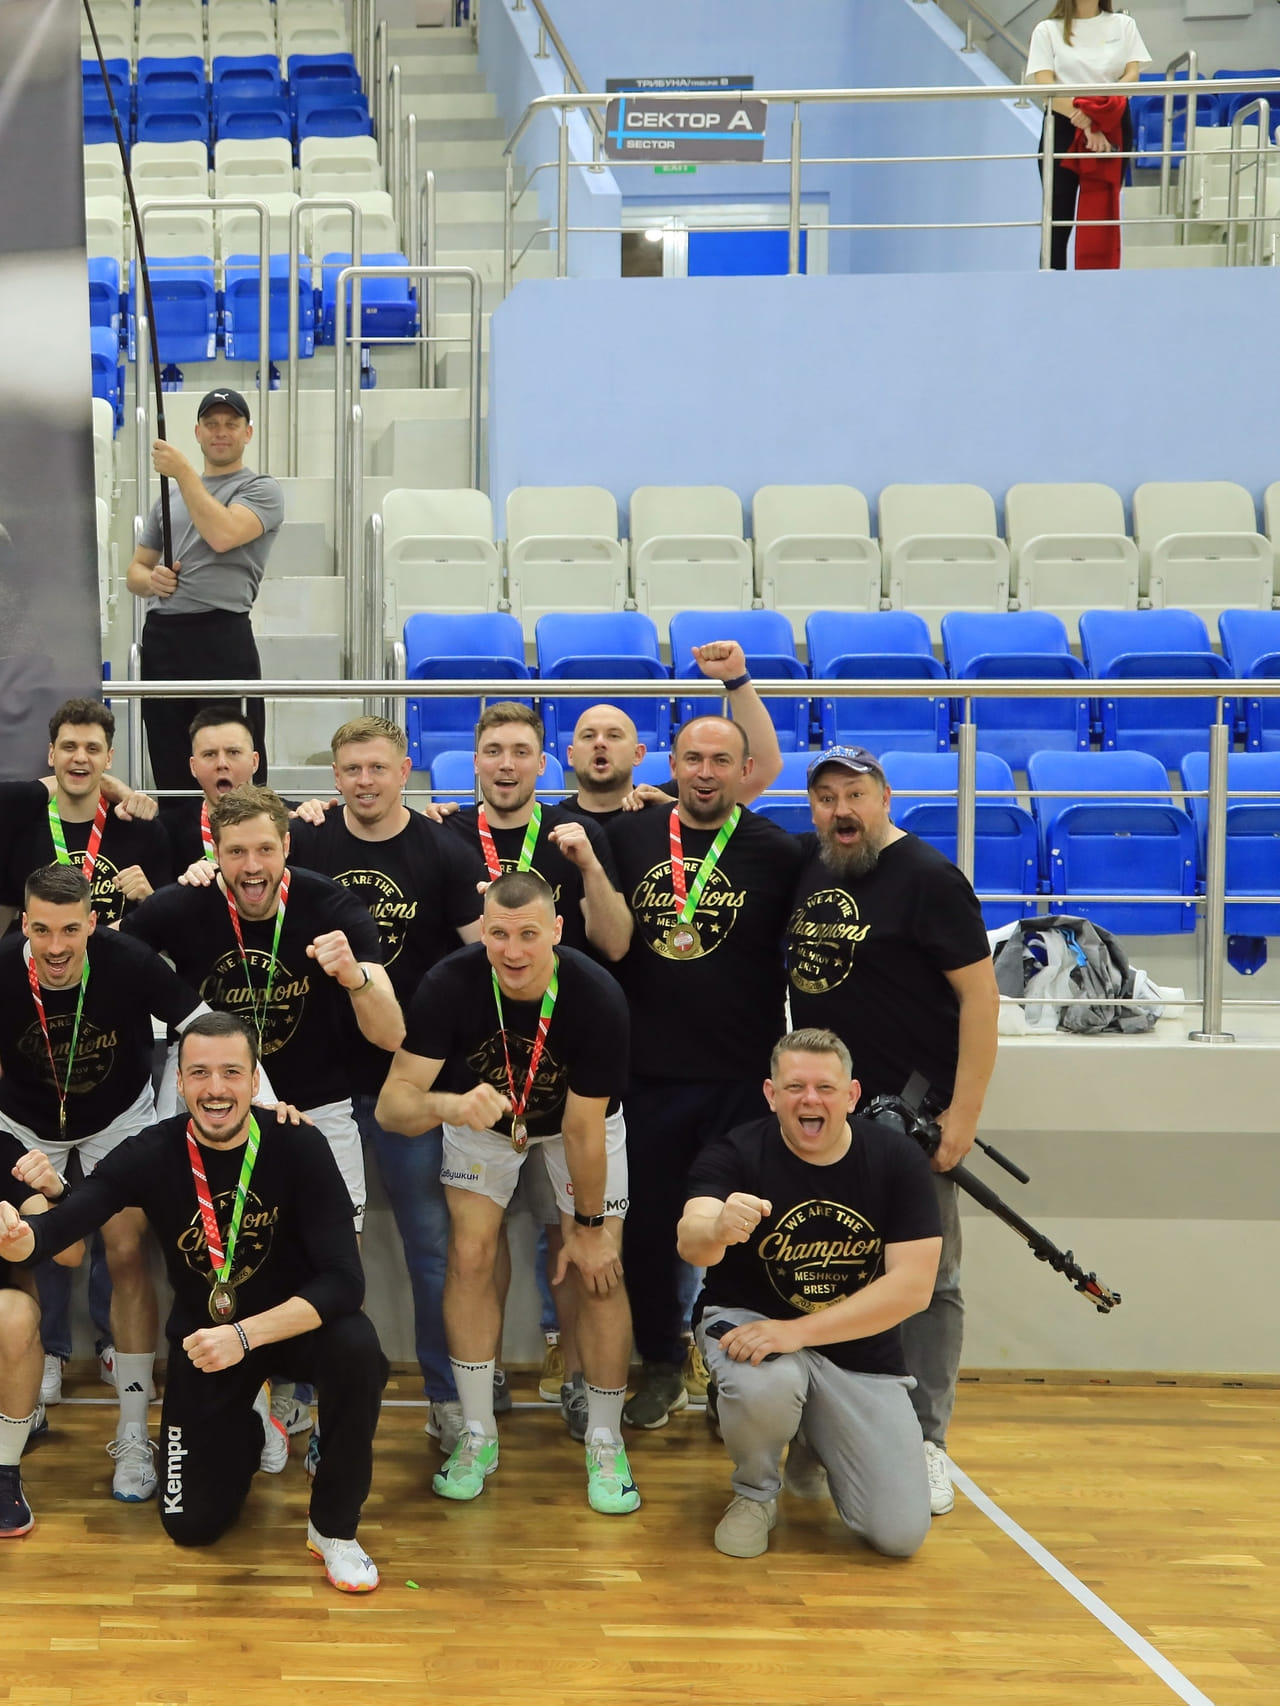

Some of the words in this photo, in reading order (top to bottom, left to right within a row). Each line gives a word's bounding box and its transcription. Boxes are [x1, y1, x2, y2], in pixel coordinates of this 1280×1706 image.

[626, 112, 720, 128] СЕКТОР
[728, 110, 753, 130] А
[626, 140, 675, 150] SECTOR
[683, 862, 699, 873] RE
[352, 875, 373, 885] ARE
[374, 877, 395, 897] THE
[837, 897, 854, 919] THE
[784, 1210, 807, 1231] WE
[808, 1205, 833, 1217] ARE
[836, 1210, 864, 1233] THE
[758, 1231, 882, 1268] Champion
[794, 1271, 849, 1281] MESHKOV
[803, 1284, 837, 1295] BREST
[163, 1425, 188, 1515] Kempa
